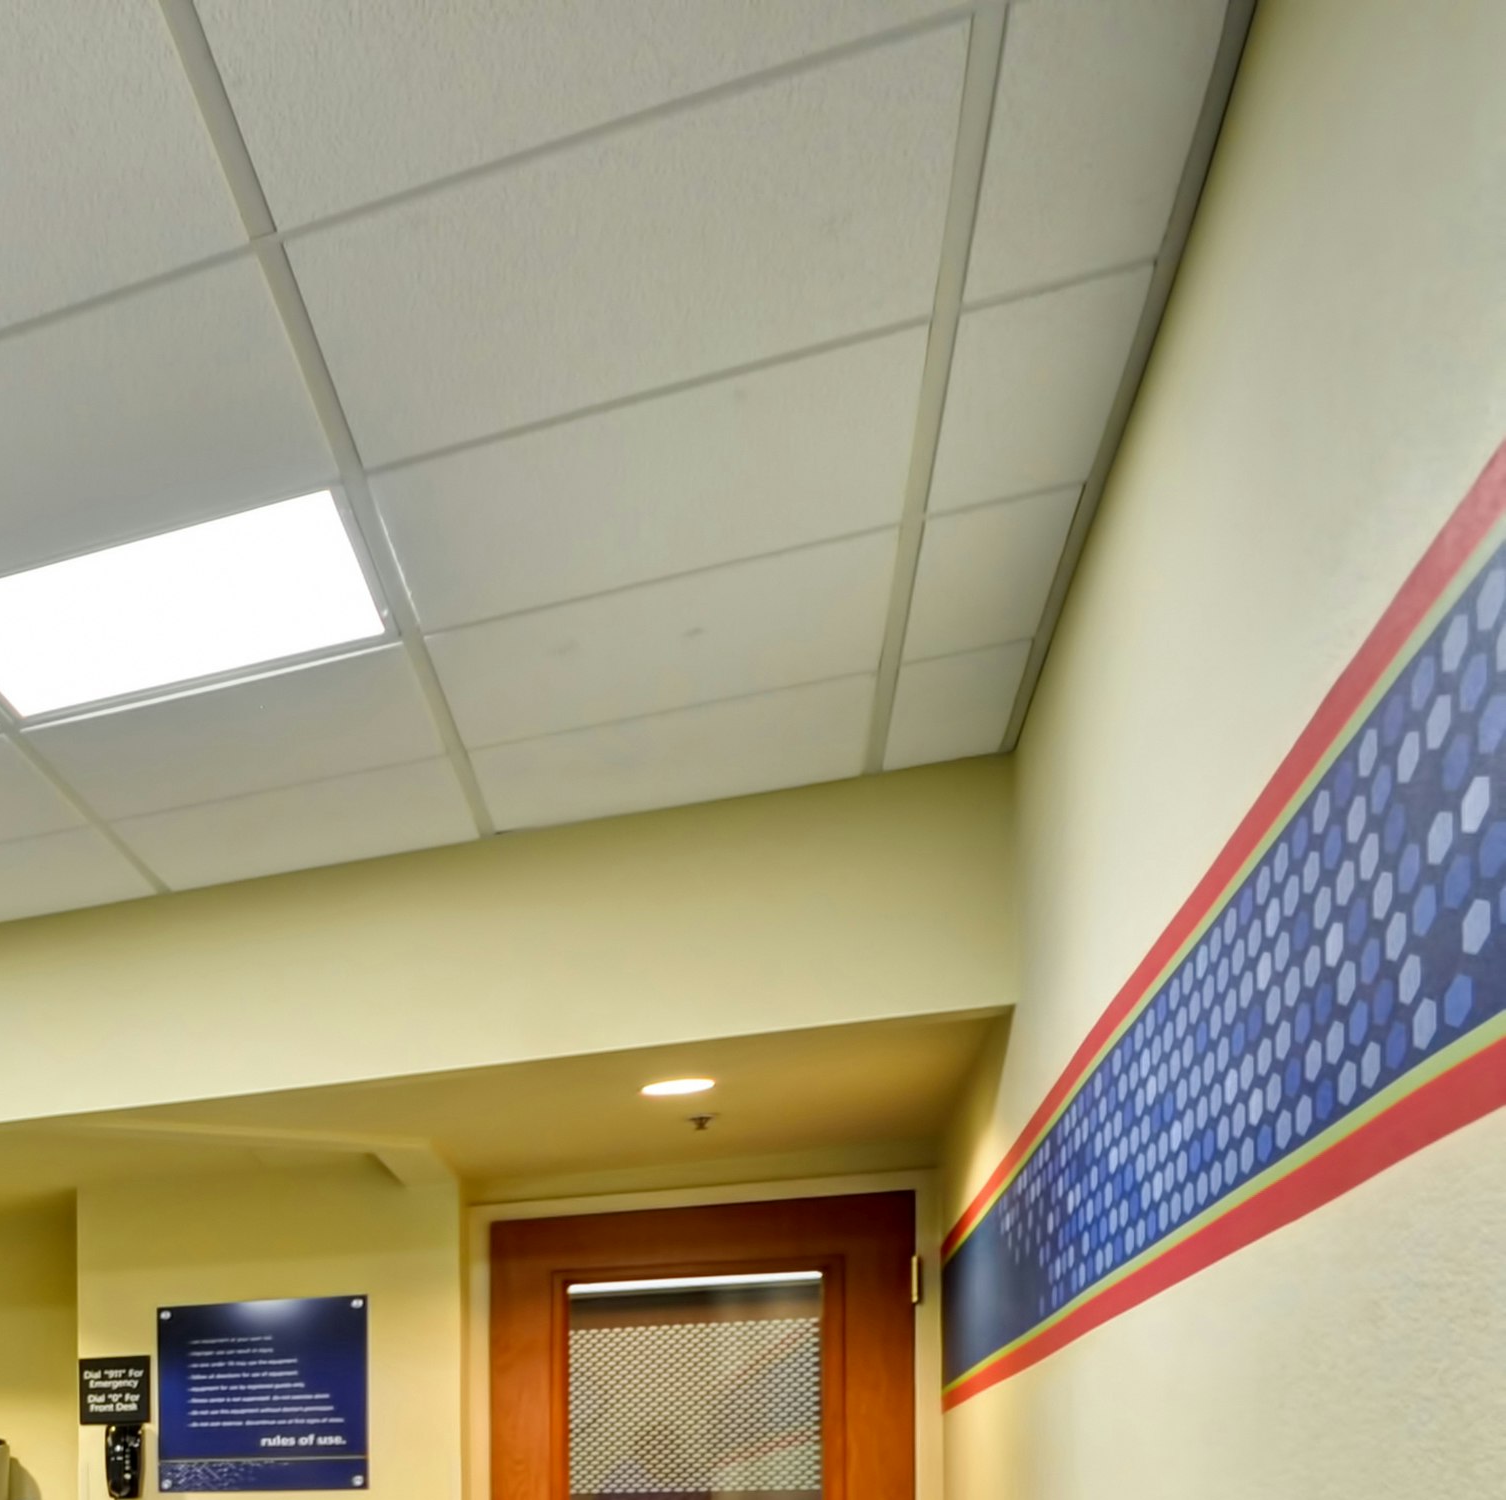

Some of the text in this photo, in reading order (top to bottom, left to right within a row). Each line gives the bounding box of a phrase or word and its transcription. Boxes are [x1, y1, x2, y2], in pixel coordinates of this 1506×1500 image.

[83, 1369, 102, 1380] Dial
[128, 1367, 144, 1378] For
[89, 1379, 140, 1390] Emergency
[87, 1393, 106, 1404] Dial
[124, 1392, 141, 1402] For
[89, 1401, 139, 1412] Front Desk
[259, 1433, 347, 1448] rules of use.
